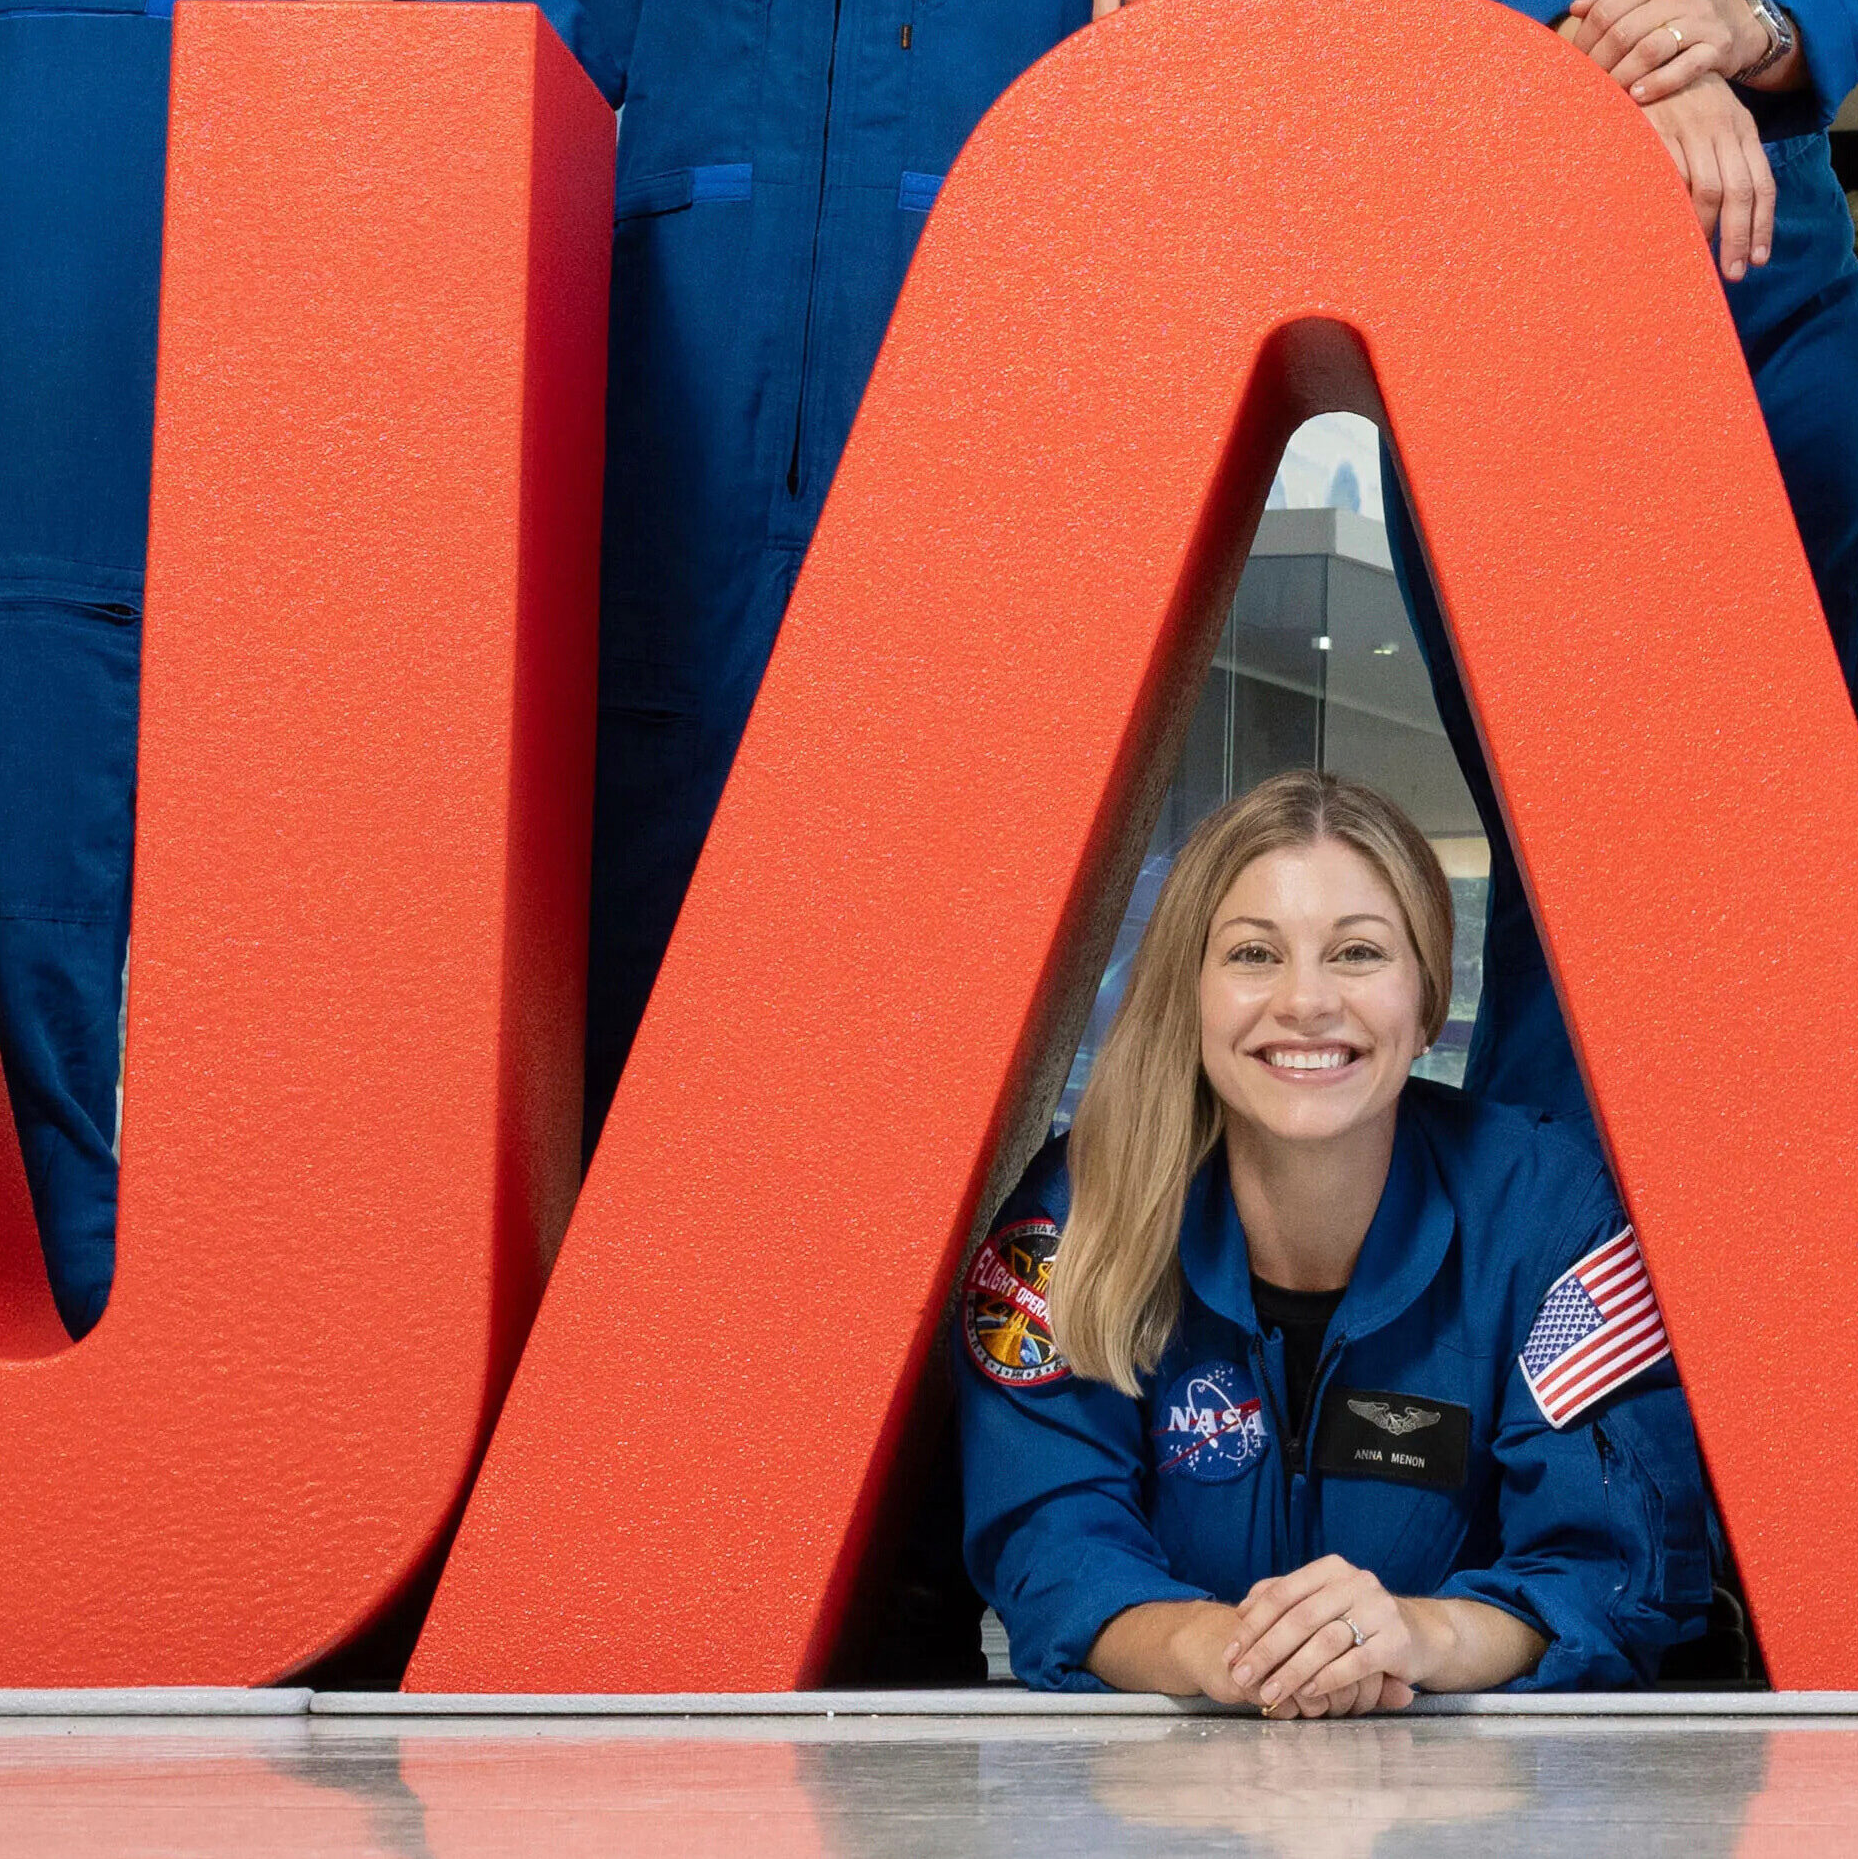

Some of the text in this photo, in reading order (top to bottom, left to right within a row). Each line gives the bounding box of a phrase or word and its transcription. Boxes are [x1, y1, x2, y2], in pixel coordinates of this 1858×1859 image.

[971, 1247, 1052, 1326] FLIGHT OPERA
[1168, 1405, 1269, 1437] NASA
[1354, 1449, 1426, 1469] ANNA MENON
